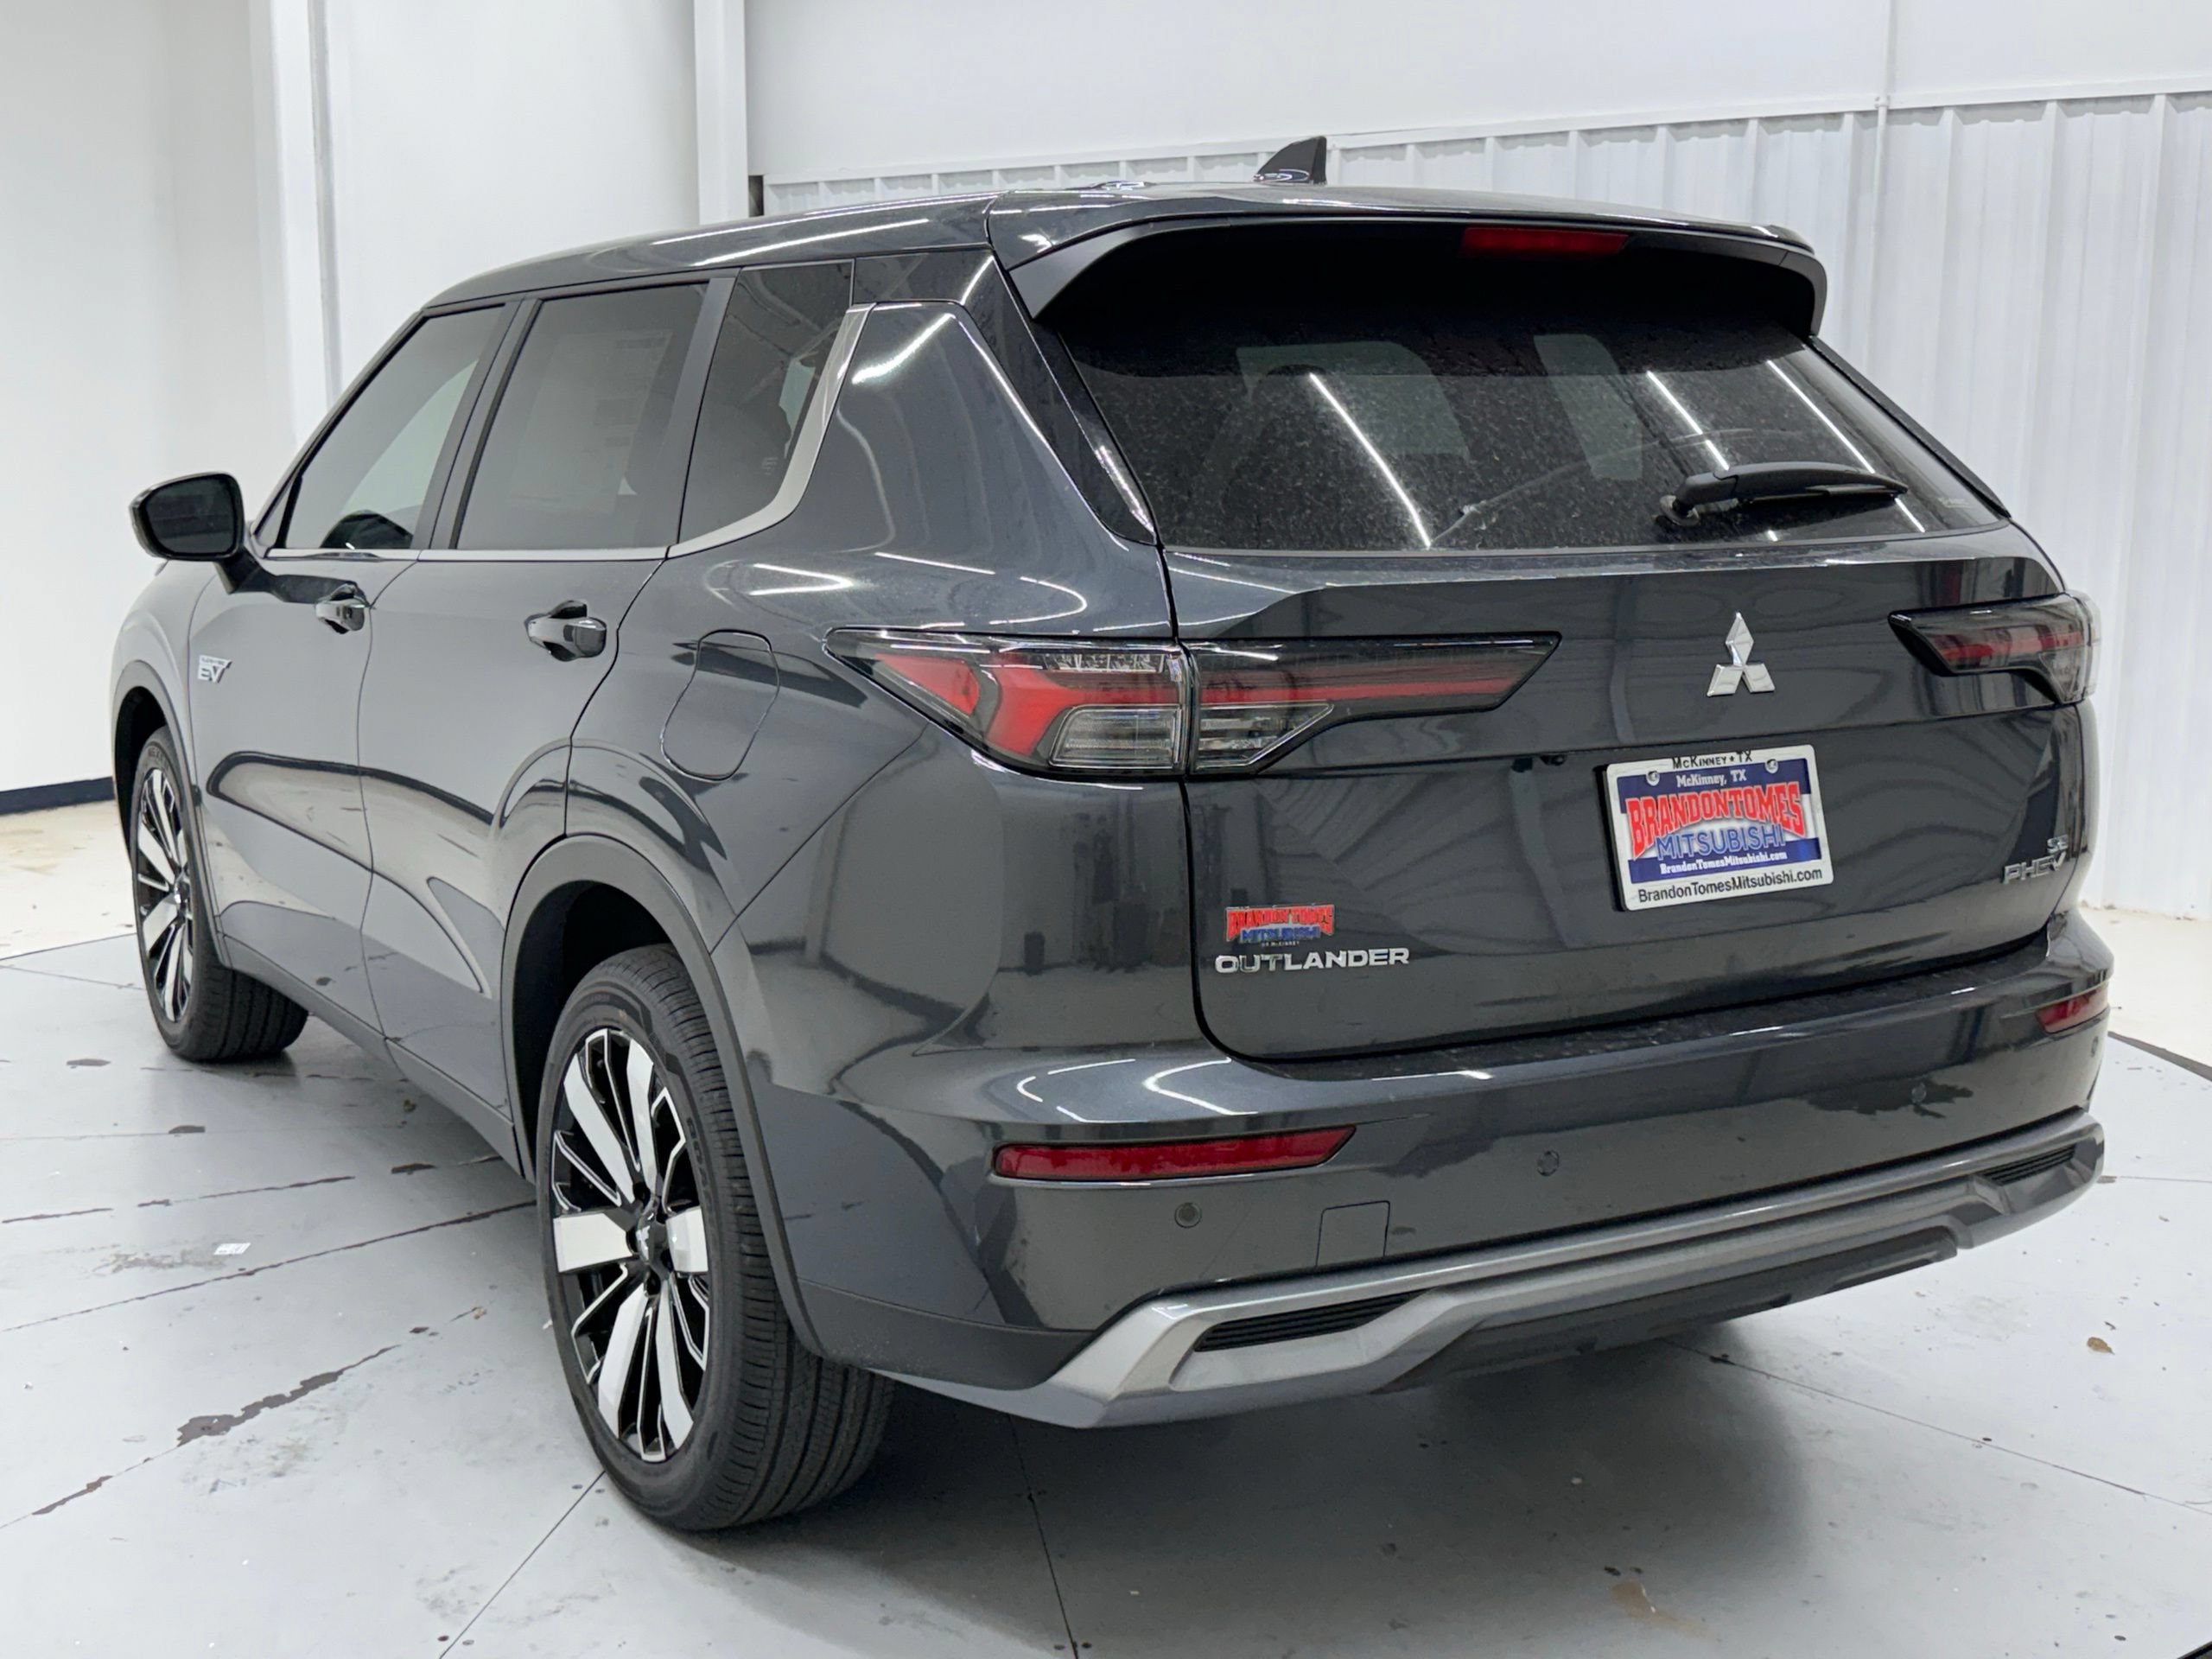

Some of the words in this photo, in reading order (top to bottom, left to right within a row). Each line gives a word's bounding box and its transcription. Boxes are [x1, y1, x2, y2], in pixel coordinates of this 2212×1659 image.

[1736, 750, 1752, 763] TX
[1676, 772, 1727, 788] McKinney,
[1730, 769, 1747, 782] TX
[1655, 824, 1787, 861] MITSUBISHI
[1659, 851, 1789, 875] BrandonTomesMitsubishi.com
[2003, 850, 2067, 885] PHEV
[1638, 868, 1823, 904] BrandonTomesMitsubishi.com
[1216, 949, 1409, 973] OUTLANDER
